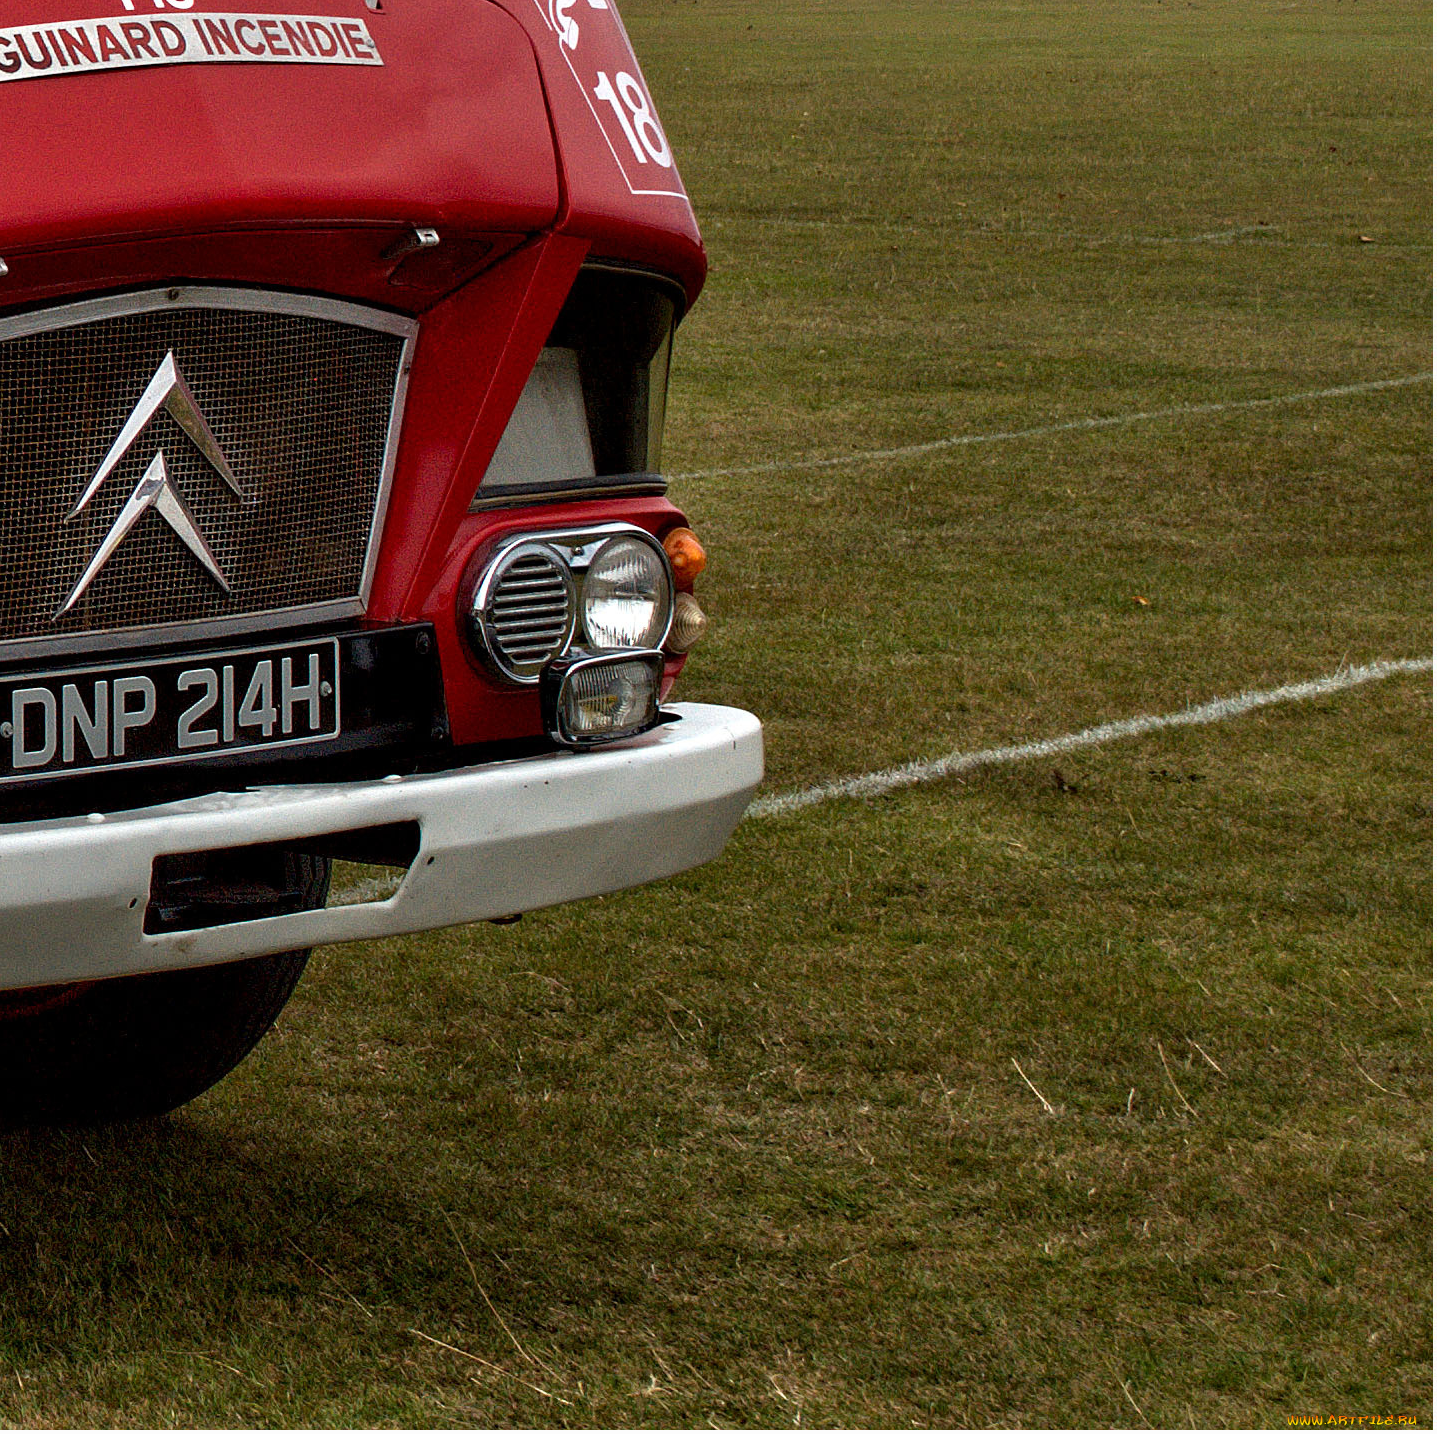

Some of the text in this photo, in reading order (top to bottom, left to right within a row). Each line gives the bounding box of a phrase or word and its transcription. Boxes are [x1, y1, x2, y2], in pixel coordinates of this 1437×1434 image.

[191, 18, 373, 60] INCENDIE
[593, 71, 672, 168] 18
[12, 653, 321, 769] DNP 214H
